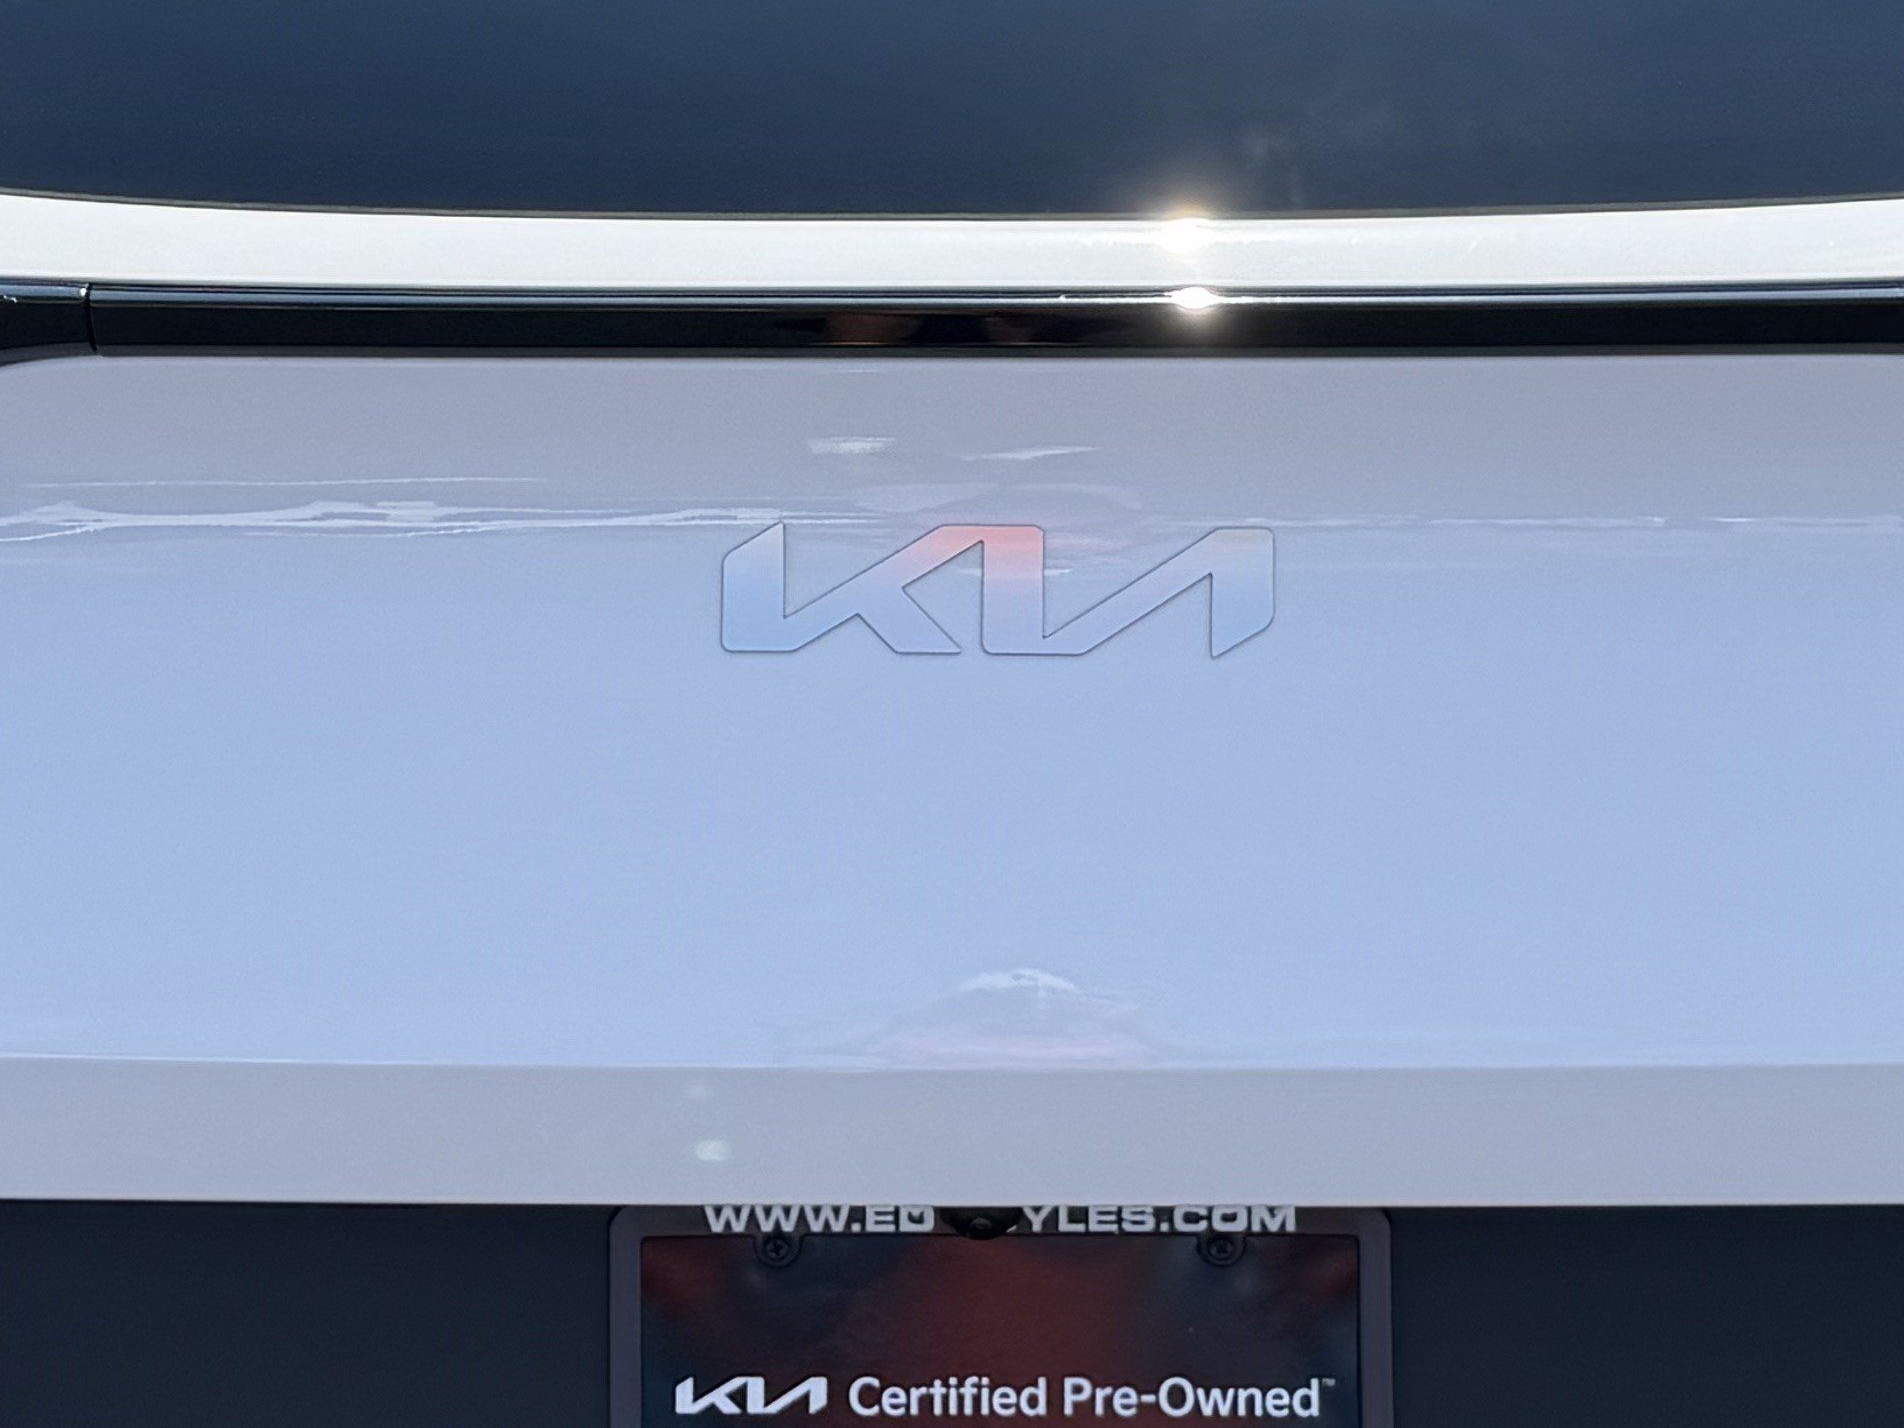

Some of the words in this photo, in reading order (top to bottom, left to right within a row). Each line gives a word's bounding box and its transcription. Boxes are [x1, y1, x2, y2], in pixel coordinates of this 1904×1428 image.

[720, 521, 1277, 659] KIA
[704, 1204, 1295, 1233] WWW.EDYLES.COM
[675, 1376, 828, 1415] KIA
[848, 1376, 1047, 1417] Certified
[1063, 1376, 1320, 1418] Pre-Owned
